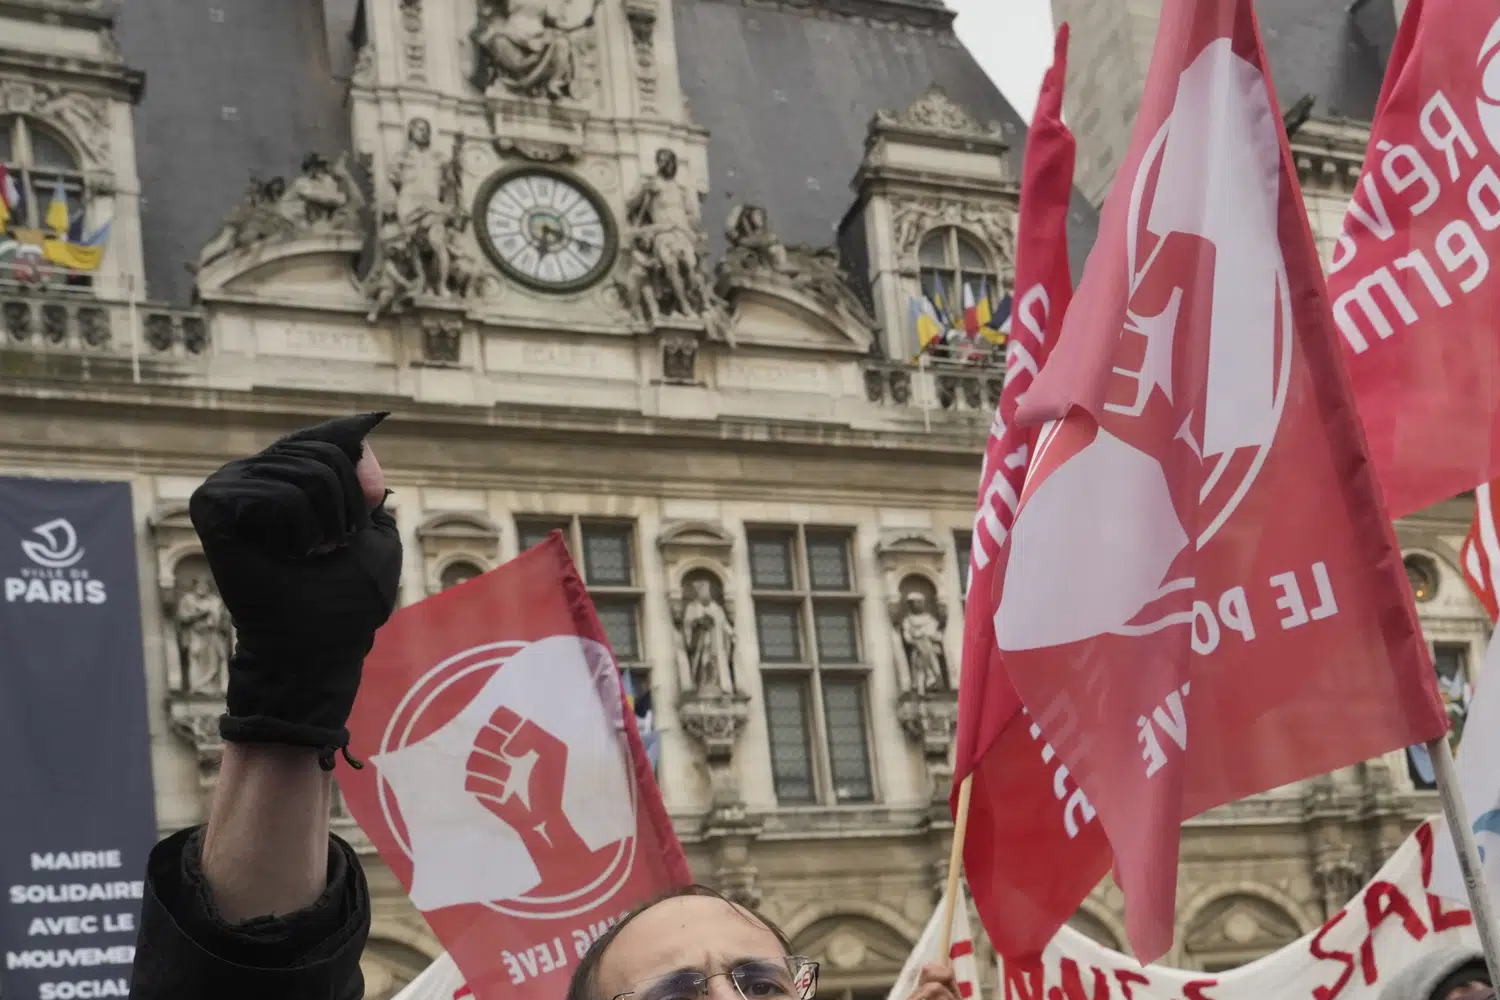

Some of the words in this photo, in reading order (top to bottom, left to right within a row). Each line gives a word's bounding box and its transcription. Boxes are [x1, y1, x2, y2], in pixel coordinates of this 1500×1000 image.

[4, 577, 107, 604] PARIS
[30, 850, 121, 871] MAIRIE
[9, 880, 144, 904] SOLIDAIRE
[28, 915, 98, 936] AVEC
[103, 913, 135, 932] LE
[38, 978, 130, 1000] SOCIAL
